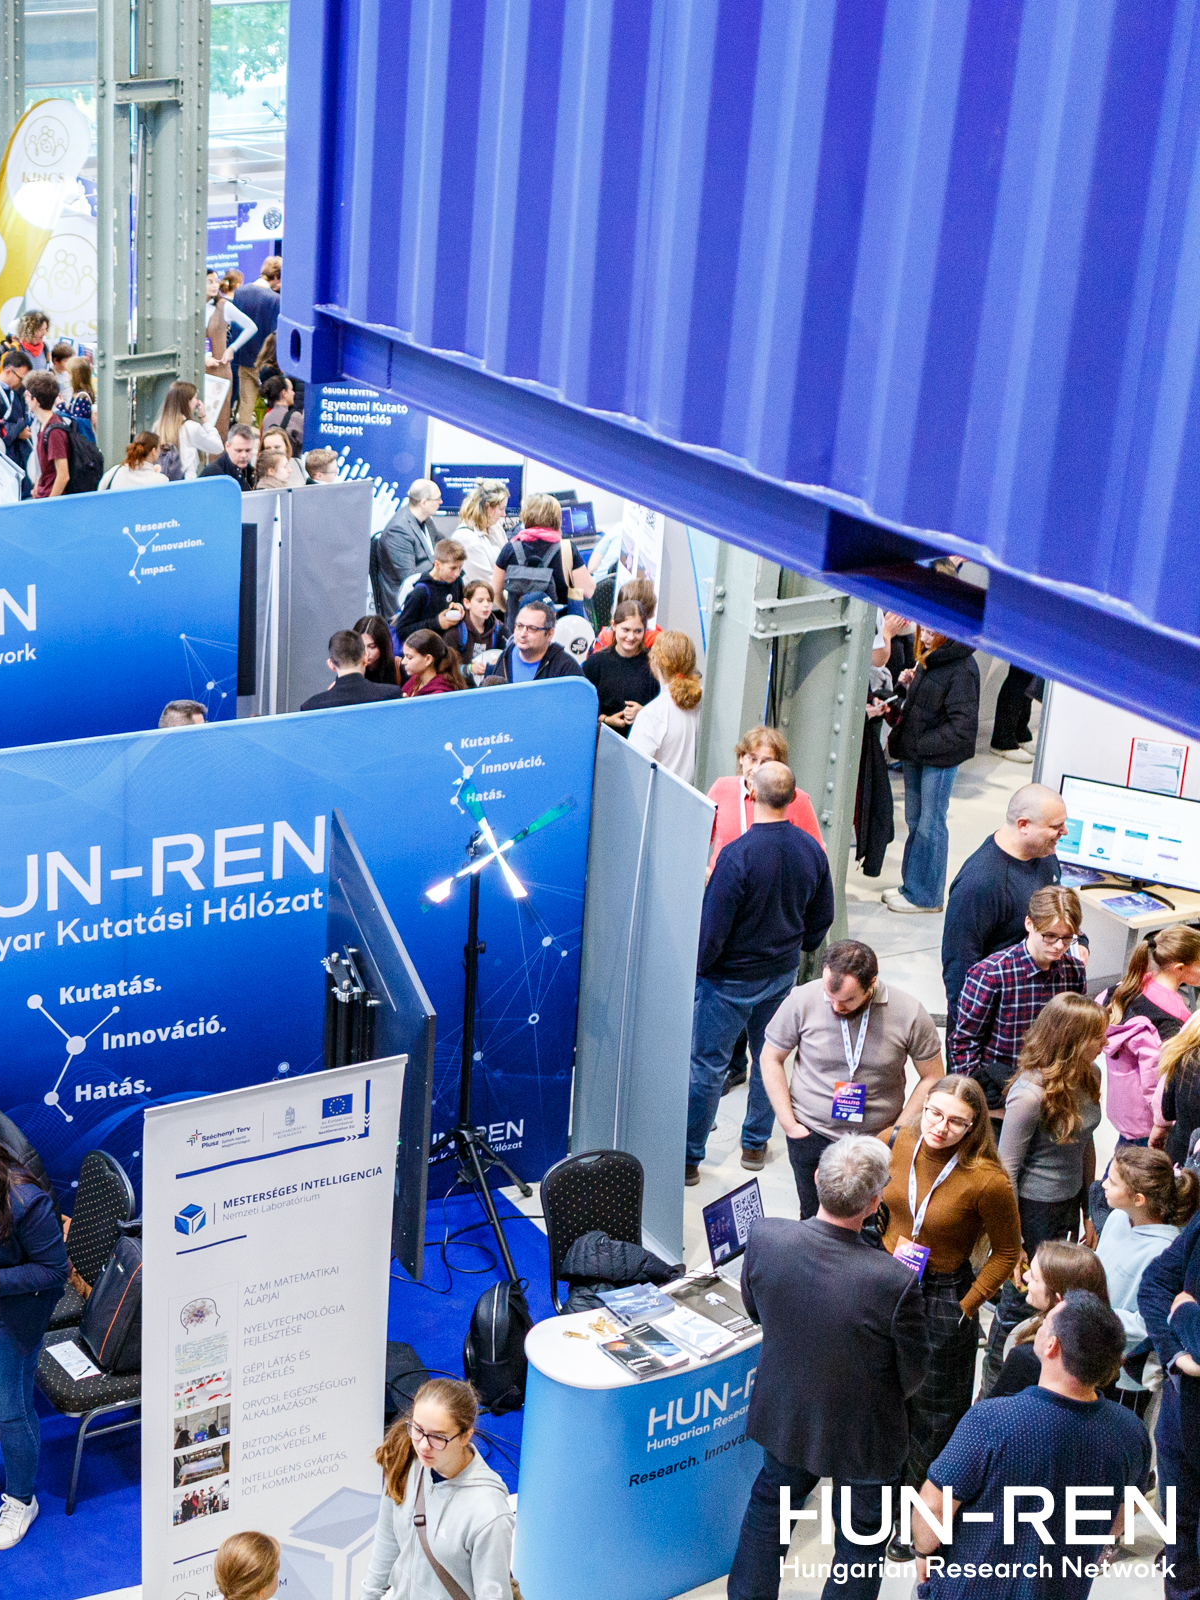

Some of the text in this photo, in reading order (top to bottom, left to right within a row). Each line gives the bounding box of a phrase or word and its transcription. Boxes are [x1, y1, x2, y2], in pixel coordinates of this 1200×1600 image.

[22, 172, 65, 183] KINCS
[321, 399, 370, 411] Egyetemi
[320, 411, 392, 425] és Innovációs
[320, 423, 363, 437] Központ
[135, 518, 180, 533] Research.
[152, 538, 204, 553] Innovation.
[141, 564, 176, 576] Impact.
[461, 732, 513, 749] Kutatás.
[481, 755, 546, 774] Innováció.
[466, 789, 505, 803] Hatás.
[57, 903, 191, 948] Kutatási
[203, 887, 324, 926] Hálózat
[59, 976, 162, 1006] Kutatás.
[102, 1015, 227, 1050] Innováció.
[74, 1078, 152, 1104] Hatás.
[201, 1126, 251, 1142] Széchenyi Terv
[201, 1139, 219, 1148] Plusz
[222, 1166, 383, 1210] MESTERSÉGES INTELLIGENCIA
[222, 1192, 320, 1222] Nemzeti Laboratórium
[243, 1265, 339, 1295] AZ MI MATEMATIKAI
[243, 1291, 280, 1307] ALAPJAI
[243, 1303, 345, 1335] NYELVTECHNOLÓGIA
[243, 1324, 303, 1347] FEJLESZTÉSE
[242, 1349, 311, 1374] GÉPI LÁTÁS ÉS
[242, 1365, 295, 1387] ÉRZÉKELÉS
[242, 1376, 356, 1411] ORVOSI, EGÉSZSÉGÜGYI
[647, 1366, 758, 1437] HUN-R
[242, 1395, 318, 1422] ALKALMAZÁSOK
[242, 1424, 311, 1450] BIZTONSÁG ÉS
[646, 1405, 750, 1453] Hungarian Resear
[241, 1431, 327, 1461] ADATOK VÉDELME
[241, 1451, 349, 1485] INTELLIGENS GYÁRTÁS,
[629, 1434, 750, 1487] Research. Innova
[241, 1463, 340, 1497] IOT, KOMMUNIKÁCIÓ
[172, 1564, 213, 1583] mi.nem
